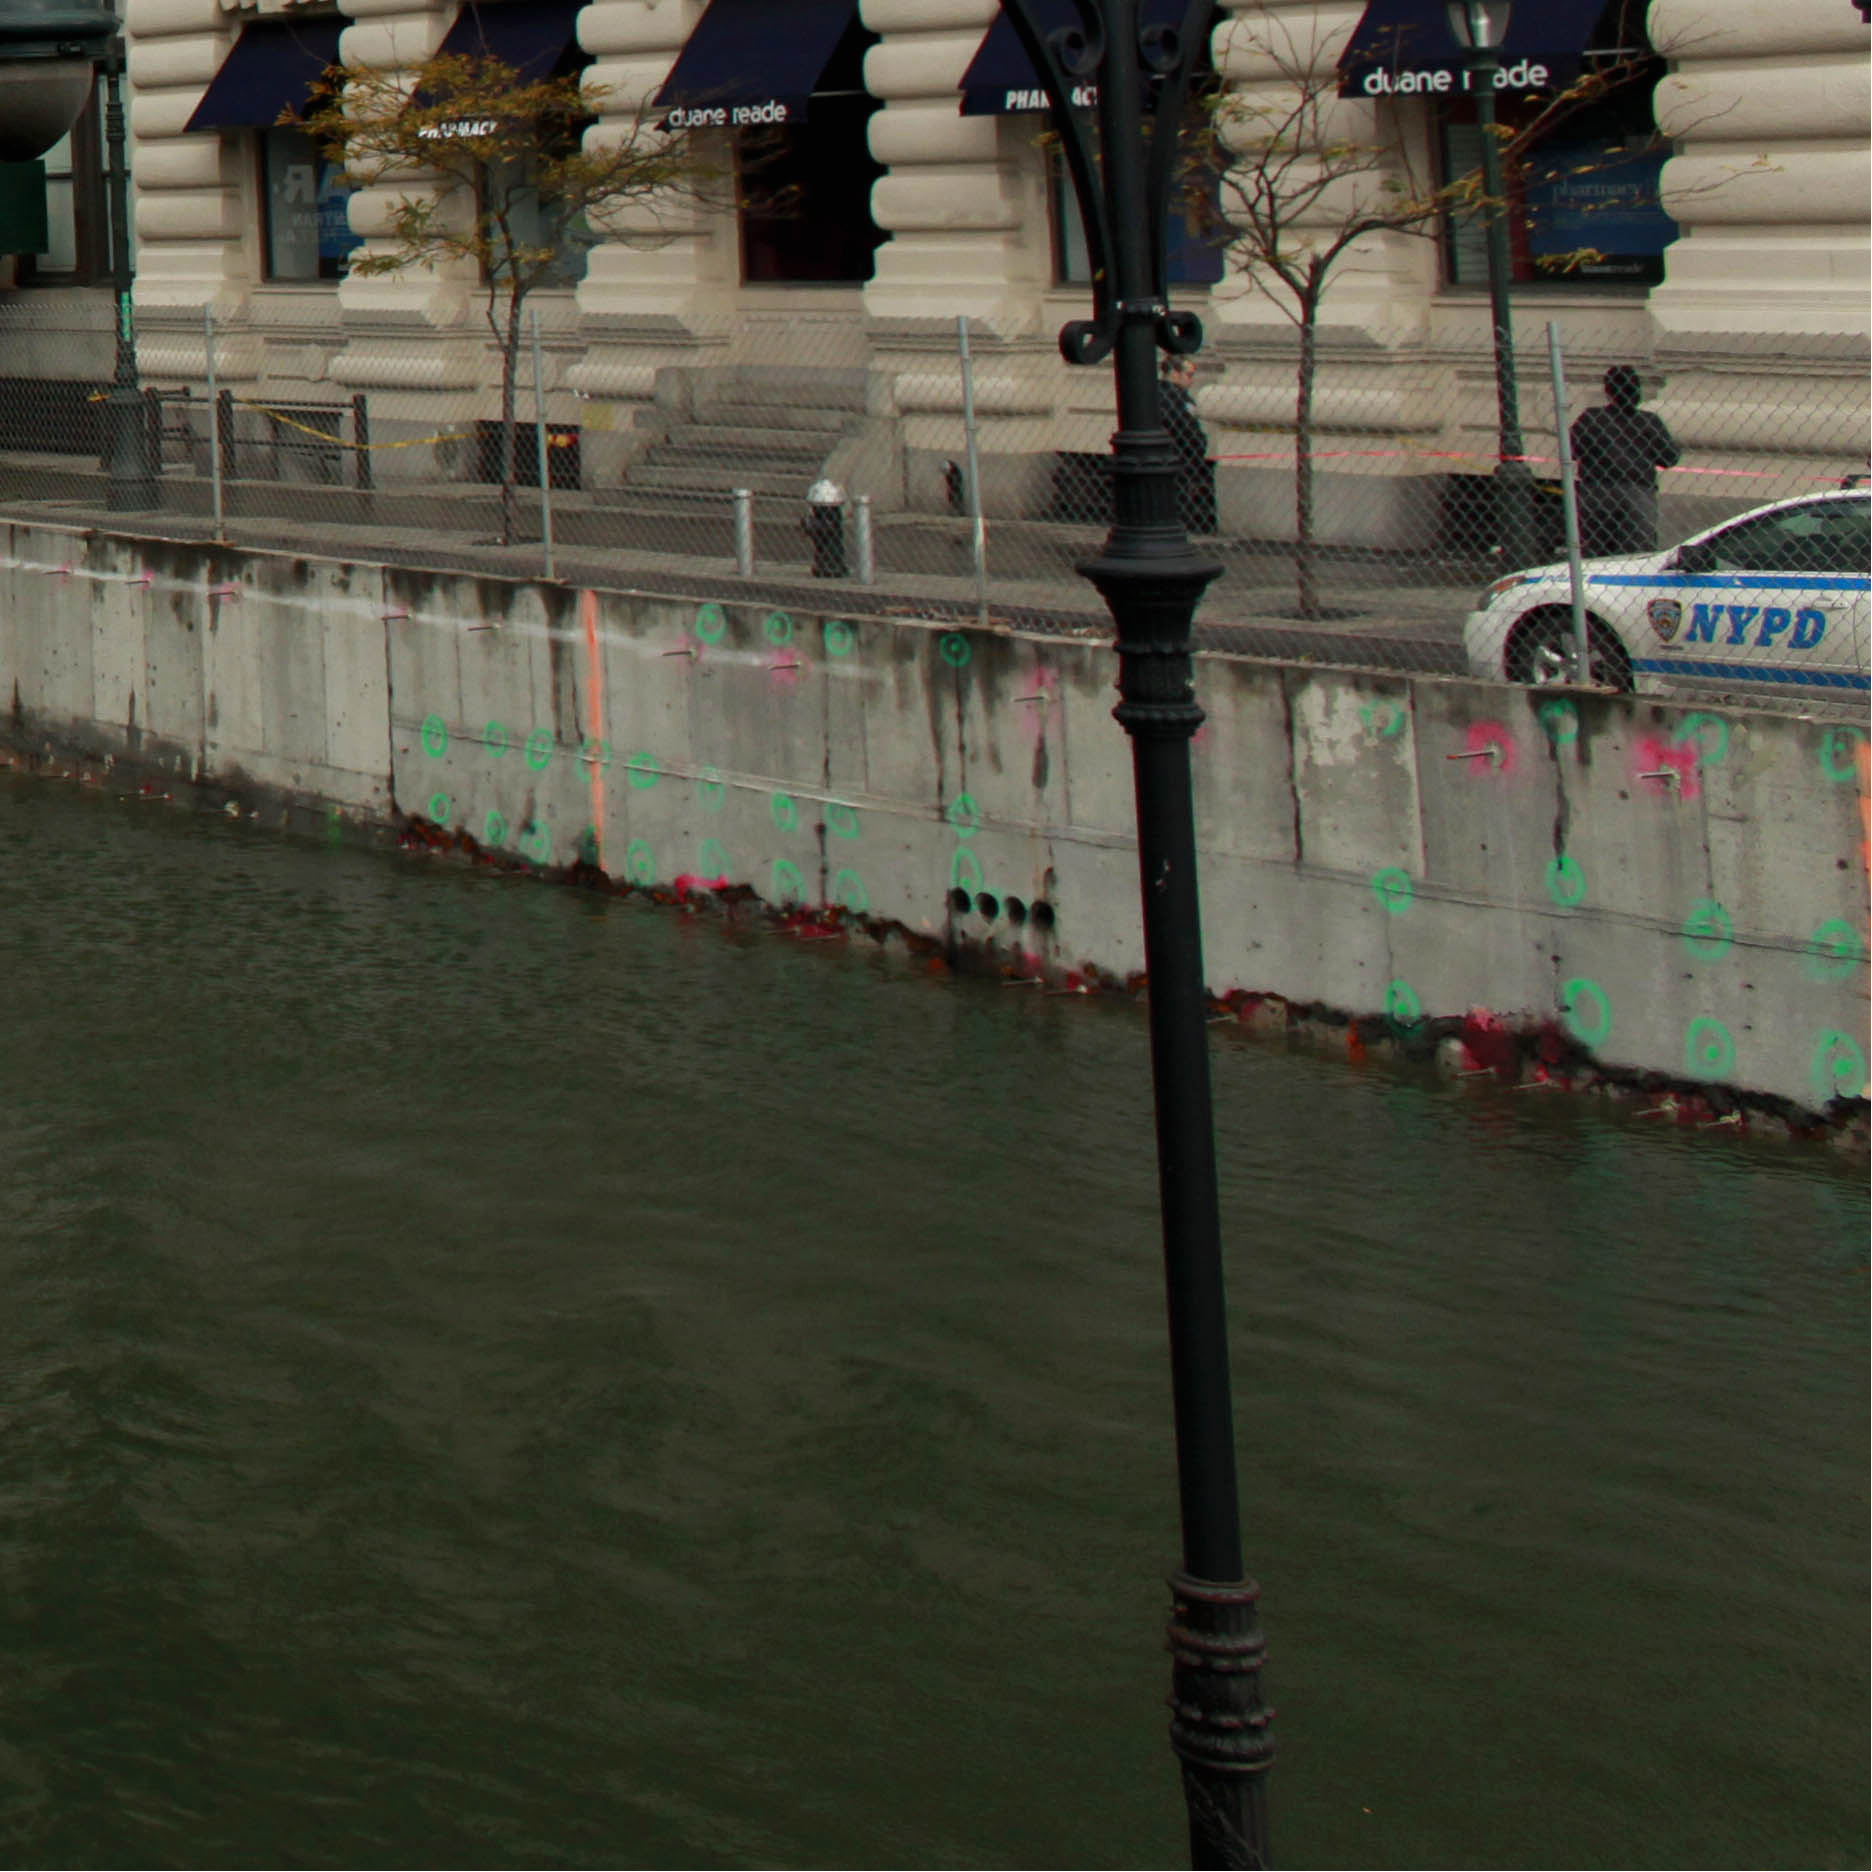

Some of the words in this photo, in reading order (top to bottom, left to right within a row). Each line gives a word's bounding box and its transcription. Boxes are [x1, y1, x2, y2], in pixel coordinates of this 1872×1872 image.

[1363, 66, 1451, 95] duane
[1462, 58, 1548, 90] rade
[669, 107, 726, 126] duane
[732, 99, 786, 124] reade
[1684, 603, 1826, 649] NYPD
